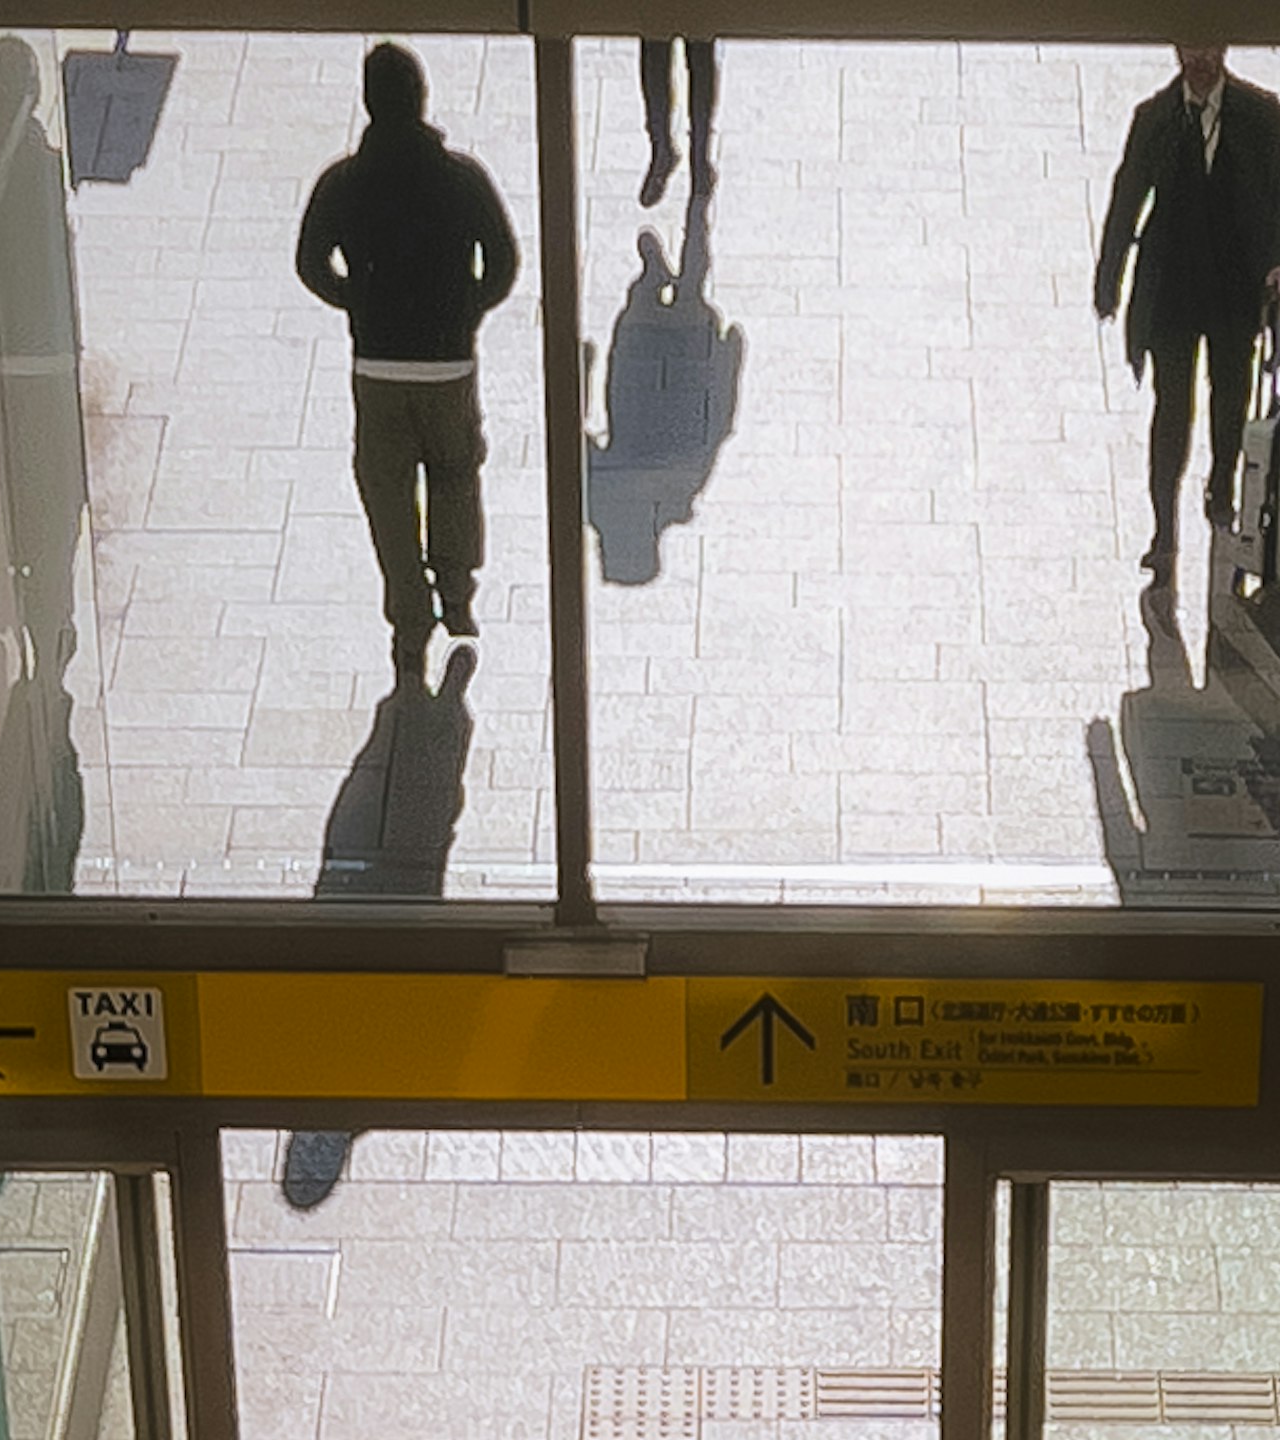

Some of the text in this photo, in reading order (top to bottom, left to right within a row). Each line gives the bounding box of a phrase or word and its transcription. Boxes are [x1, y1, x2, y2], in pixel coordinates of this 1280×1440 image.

[75, 992, 153, 1017] TAXI
[847, 1037, 962, 1060] South Exit
